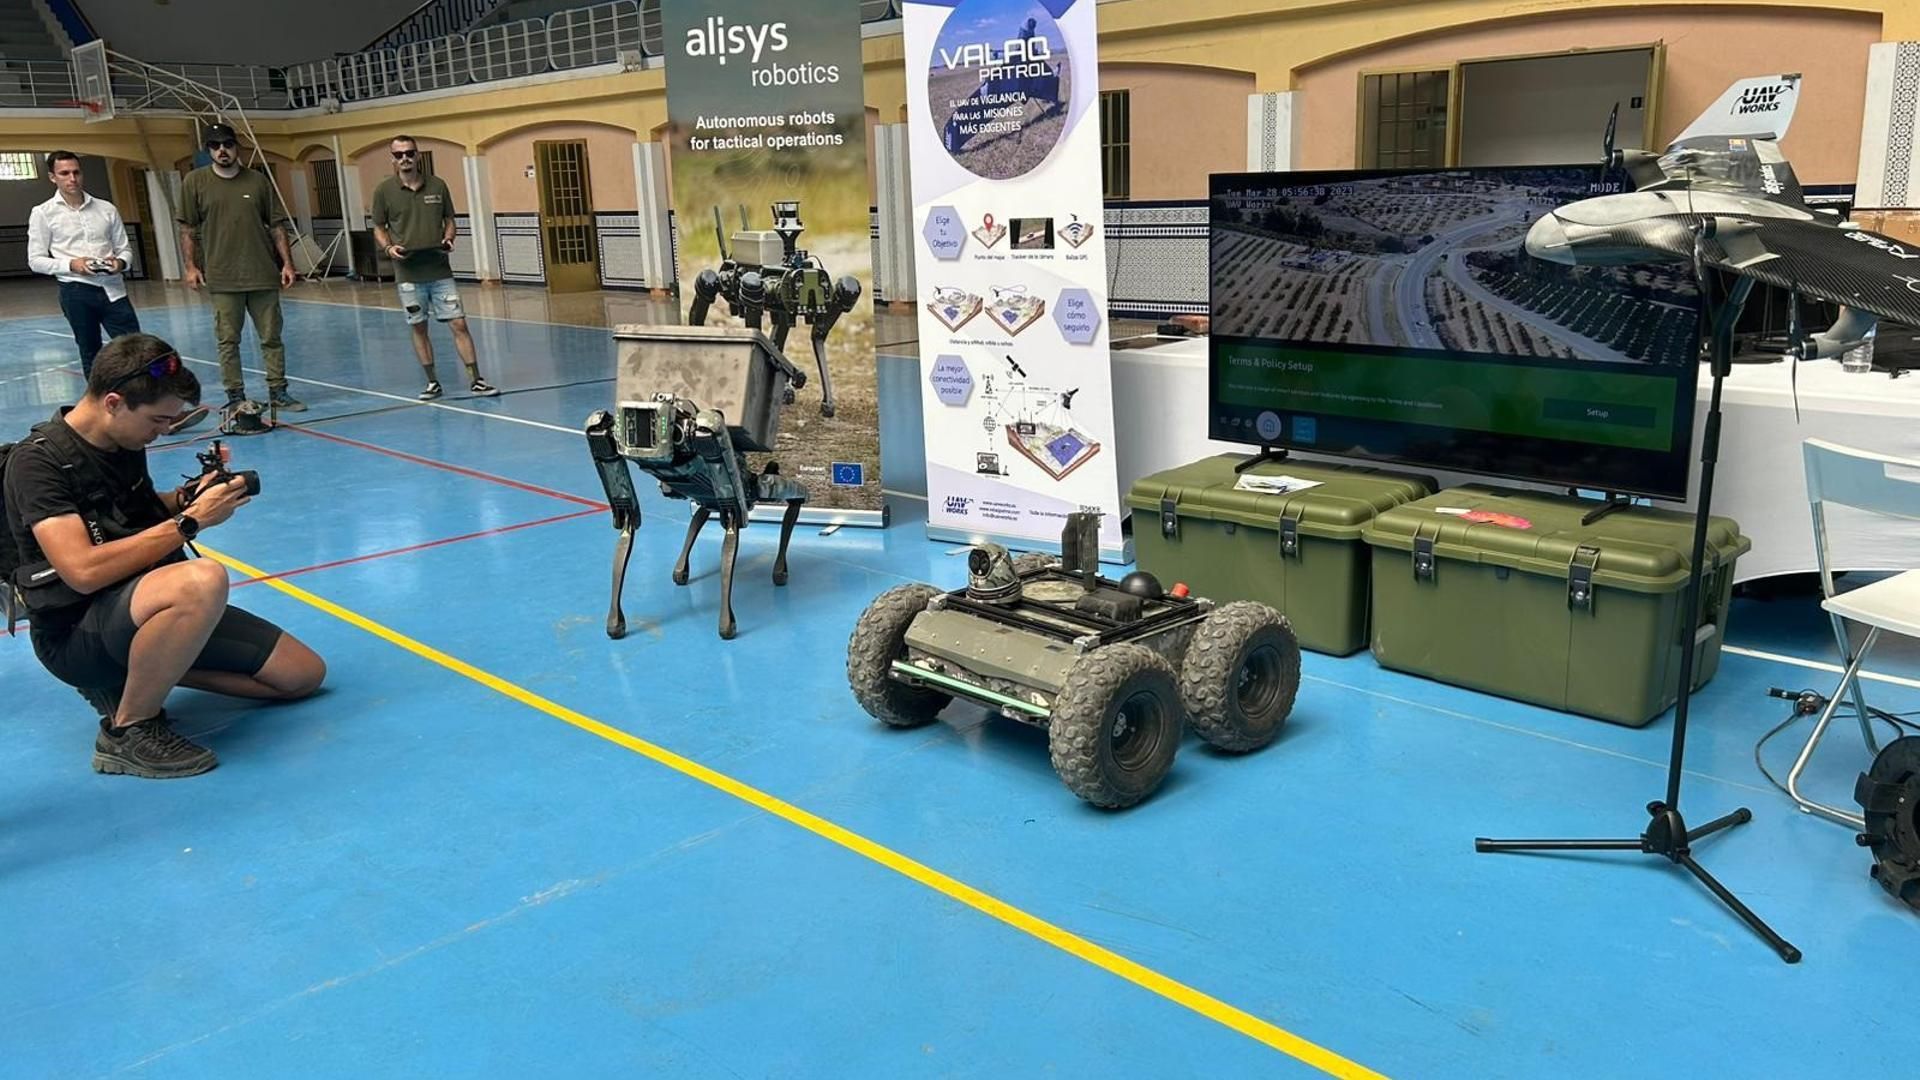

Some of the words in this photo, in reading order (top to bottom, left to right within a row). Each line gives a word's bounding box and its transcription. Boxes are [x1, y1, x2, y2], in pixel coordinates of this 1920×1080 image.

[685, 16, 789, 65] alisys
[939, 36, 1051, 70] VALAQ
[752, 62, 840, 87] robotics
[979, 62, 1053, 82] PATROL
[949, 99, 956, 108] EL
[970, 97, 979, 106] DE
[980, 91, 1027, 105] VIGILANCIA
[1743, 85, 1781, 104] UAV
[952, 112, 969, 121] PARA
[970, 111, 981, 120] LAS
[983, 106, 1023, 119] MISIONES
[1739, 102, 1780, 114] WORKS
[695, 113, 785, 130] Autonomous
[789, 111, 835, 126] robots
[960, 122, 978, 134] MÁS
[980, 121, 1021, 133] EXIGENTES
[690, 137, 710, 150] for
[713, 134, 763, 150] tactical
[767, 133, 843, 150] operations
[1226, 189, 1241, 197] Tue
[1246, 189, 1260, 197] Mar
[1266, 188, 1277, 197] 28
[1330, 186, 1353, 196] 2023
[1590, 182, 1620, 193] MODE
[935, 216, 950, 226] Elige
[932, 239, 958, 249] Objetivo
[1067, 299, 1084, 309] Elige
[1067, 310, 1086, 320] cómo
[1063, 322, 1090, 333] seguirlo
[946, 365, 963, 374] mejor
[1229, 355, 1252, 366] Terms
[1261, 358, 1286, 370] Policy
[1287, 360, 1313, 373] Setup
[931, 376, 970, 384] conectividad
[941, 386, 962, 395] posible
[1587, 408, 1609, 418] Setup
[947, 496, 967, 508] UAV
[946, 507, 968, 515] WORKS
[88, 520, 103, 545] ONY
